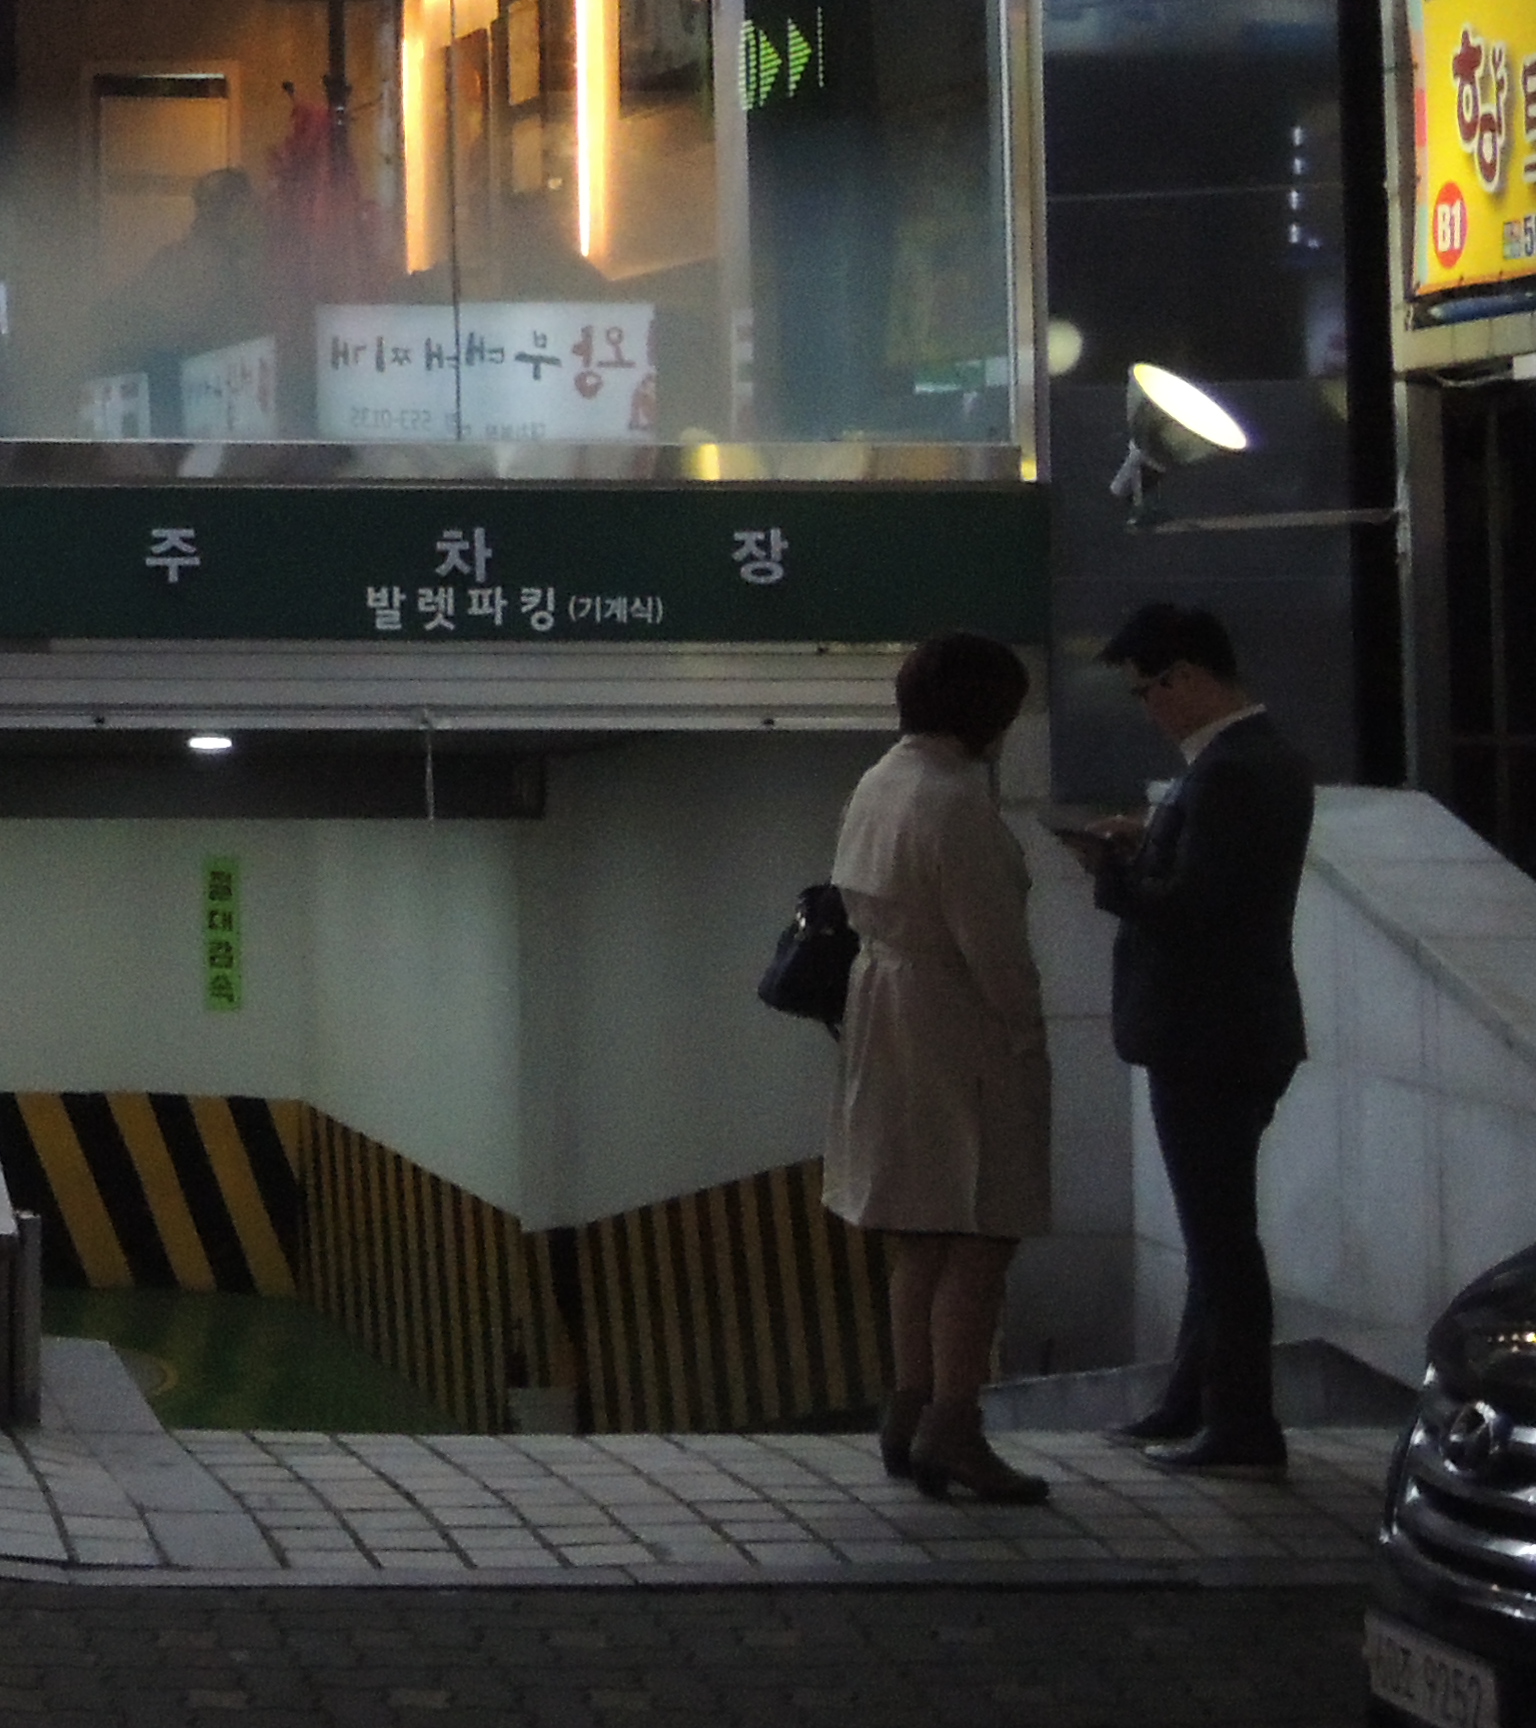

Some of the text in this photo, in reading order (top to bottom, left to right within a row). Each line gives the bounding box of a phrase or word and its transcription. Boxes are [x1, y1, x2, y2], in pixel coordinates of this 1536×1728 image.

[1436, 199, 1462, 255] B1
[366, 587, 665, 632] 발렛파킹 (기계식)
